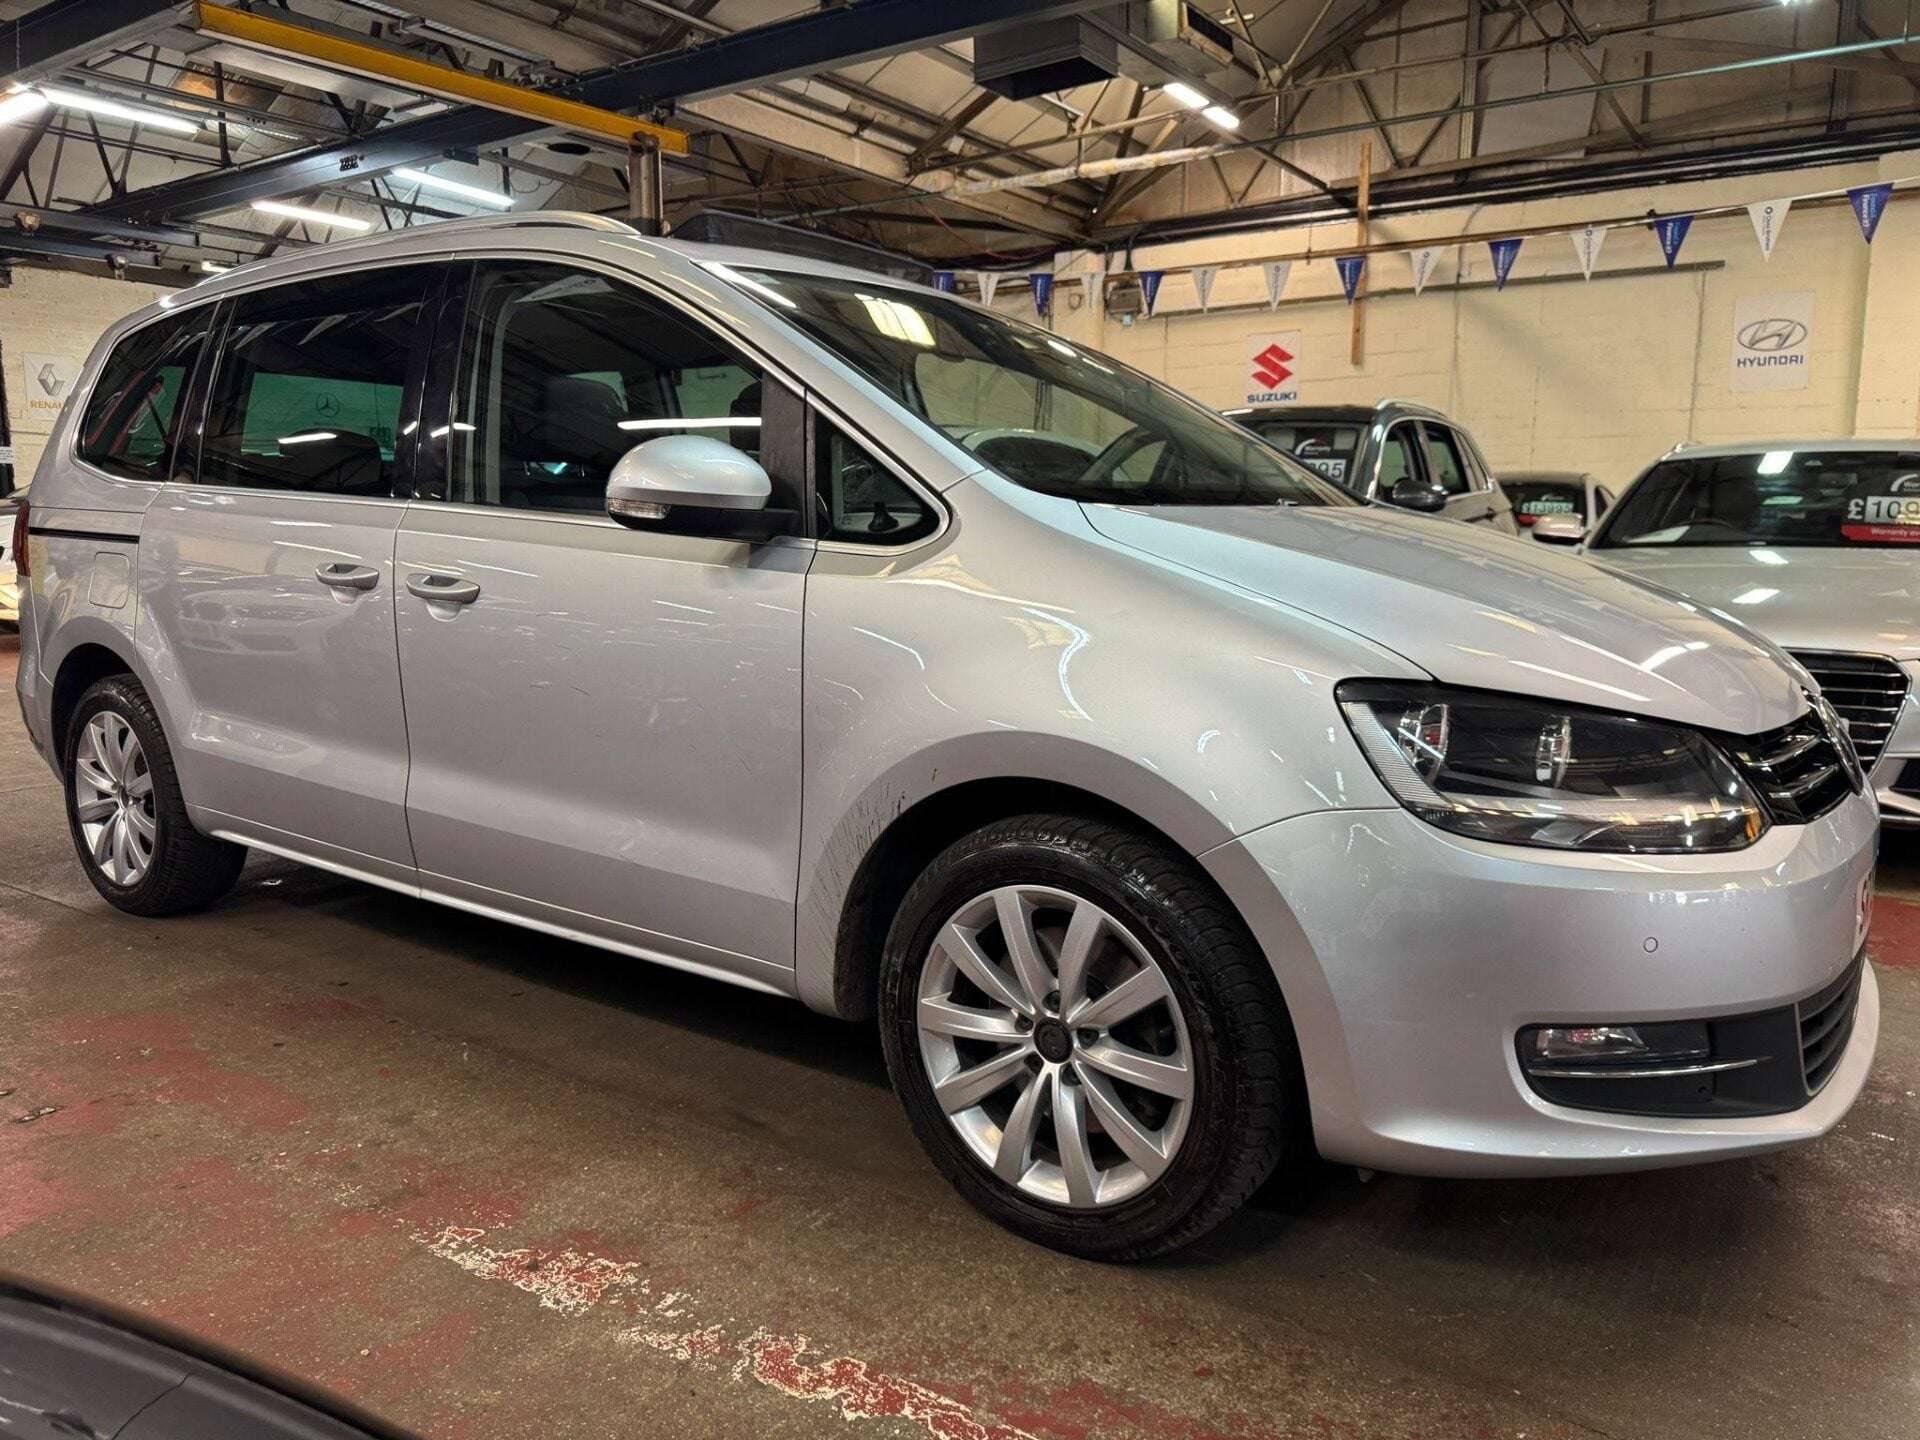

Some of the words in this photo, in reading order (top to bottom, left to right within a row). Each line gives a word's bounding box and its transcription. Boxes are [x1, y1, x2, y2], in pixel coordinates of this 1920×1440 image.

[1737, 355, 1804, 368] HYUNDAI
[1247, 391, 1297, 403] SUZUKI
[1309, 462, 1344, 480] 95
